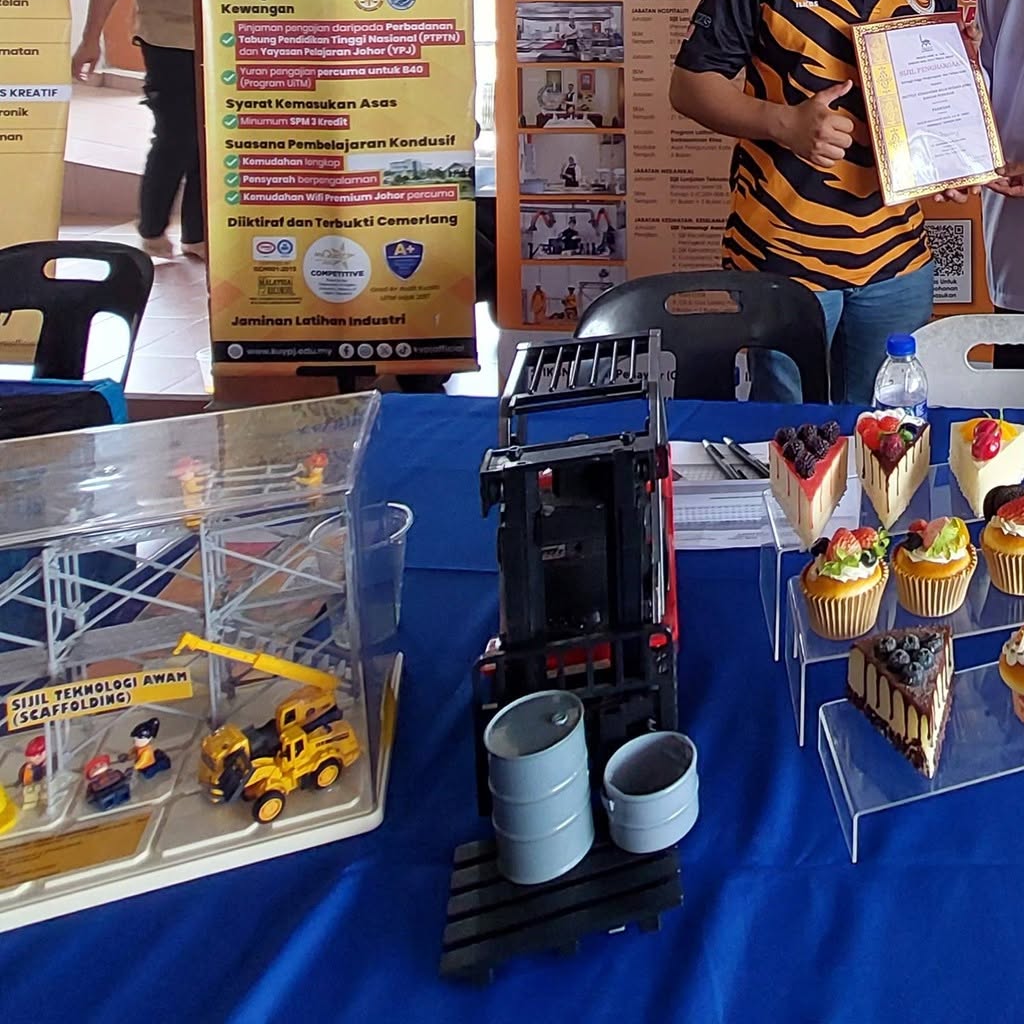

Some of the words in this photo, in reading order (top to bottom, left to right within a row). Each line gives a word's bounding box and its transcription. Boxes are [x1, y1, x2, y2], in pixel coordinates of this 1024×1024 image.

[221, 4, 295, 17] Kewangan
[238, 36, 277, 46] Tabung
[278, 35, 330, 44] Pendidikan
[332, 34, 366, 46] Tinggi
[368, 33, 417, 43] Nasional
[419, 33, 460, 43] (PTPTN)
[10, 89, 58, 97] KREATIF
[226, 99, 273, 111] Syarat
[276, 99, 356, 109] Kemasukan
[360, 98, 397, 108] Asas
[225, 139, 286, 149] Suasana
[288, 138, 386, 153] Pembelajaran
[389, 135, 456, 147] Kondusif
[243, 193, 304, 201] Kemudahan
[325, 193, 372, 202] Premium
[375, 191, 404, 200] Johor
[406, 189, 455, 201] percuma
[228, 217, 285, 228] Diiktiraf
[287, 217, 313, 227] dan
[315, 216, 375, 227] Terbukti
[377, 214, 458, 227] Cemerlang
[232, 315, 293, 326] Jaminan
[296, 315, 346, 326] Latihan
[350, 314, 406, 326] Industri
[12, 693, 49, 711] SIJIL
[54, 677, 137, 700] TEKNOLOGI
[143, 672, 187, 685] AWAM
[13, 691, 131, 726] (SCAFFOLDING)
